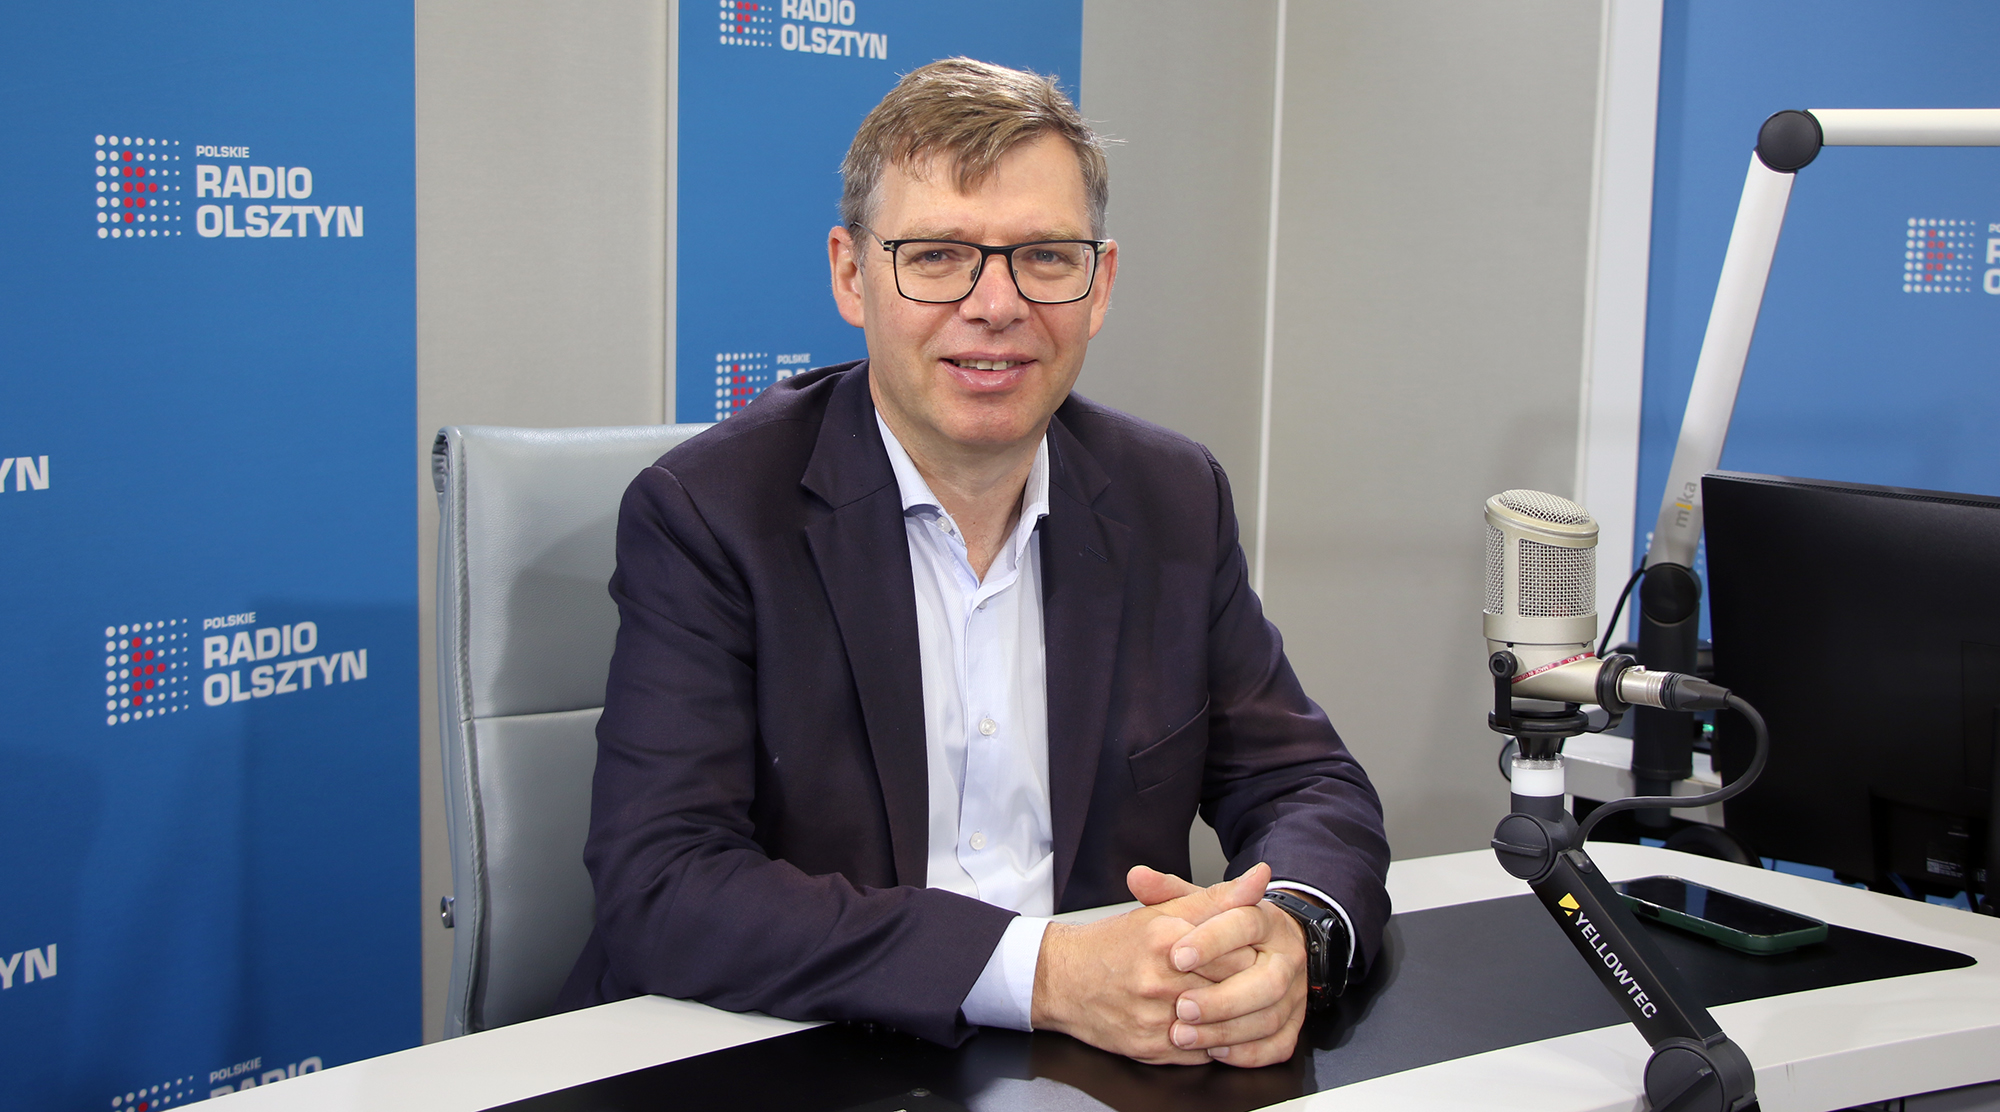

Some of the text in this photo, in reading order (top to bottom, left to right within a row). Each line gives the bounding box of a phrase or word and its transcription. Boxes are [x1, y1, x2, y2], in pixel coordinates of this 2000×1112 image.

[781, 0, 855, 26] RADIO
[781, 23, 888, 60] OLSZTYN
[196, 145, 250, 158] POLSKIE
[196, 164, 313, 199] RADIO
[196, 204, 364, 238] OLSZTYN
[777, 353, 811, 365] POLSKIE
[203, 612, 257, 630] POLSKIE
[203, 621, 318, 669] RADIO
[203, 649, 368, 707] OLSZTYN
[1574, 911, 1657, 1018] YELLOWTEC
[209, 1057, 262, 1085] POLSKIE
